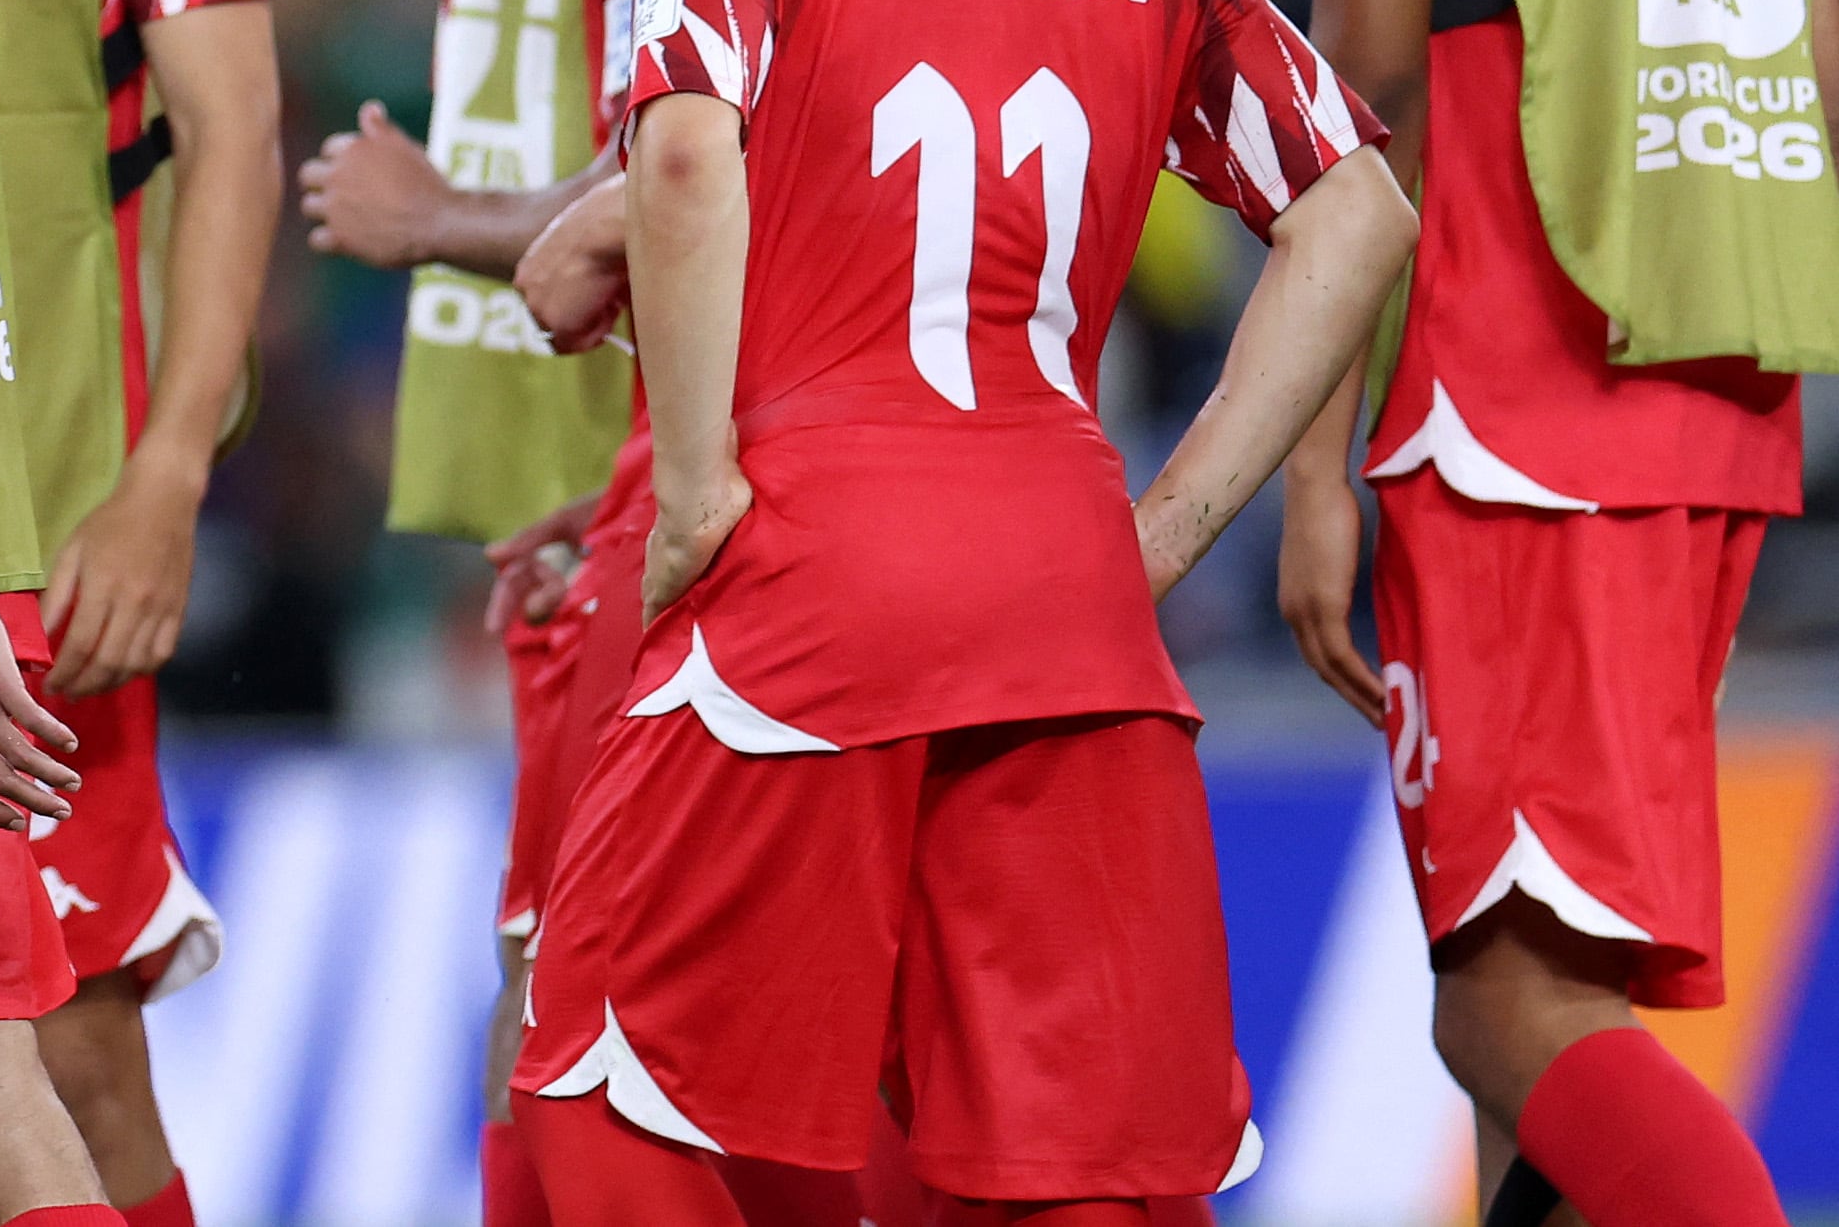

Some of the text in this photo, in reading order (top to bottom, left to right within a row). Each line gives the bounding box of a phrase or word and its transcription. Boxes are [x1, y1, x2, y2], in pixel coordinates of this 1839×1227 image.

[1735, 77, 1817, 113] CUP
[1635, 105, 1824, 182] 2026
[871, 60, 1092, 411] 11
